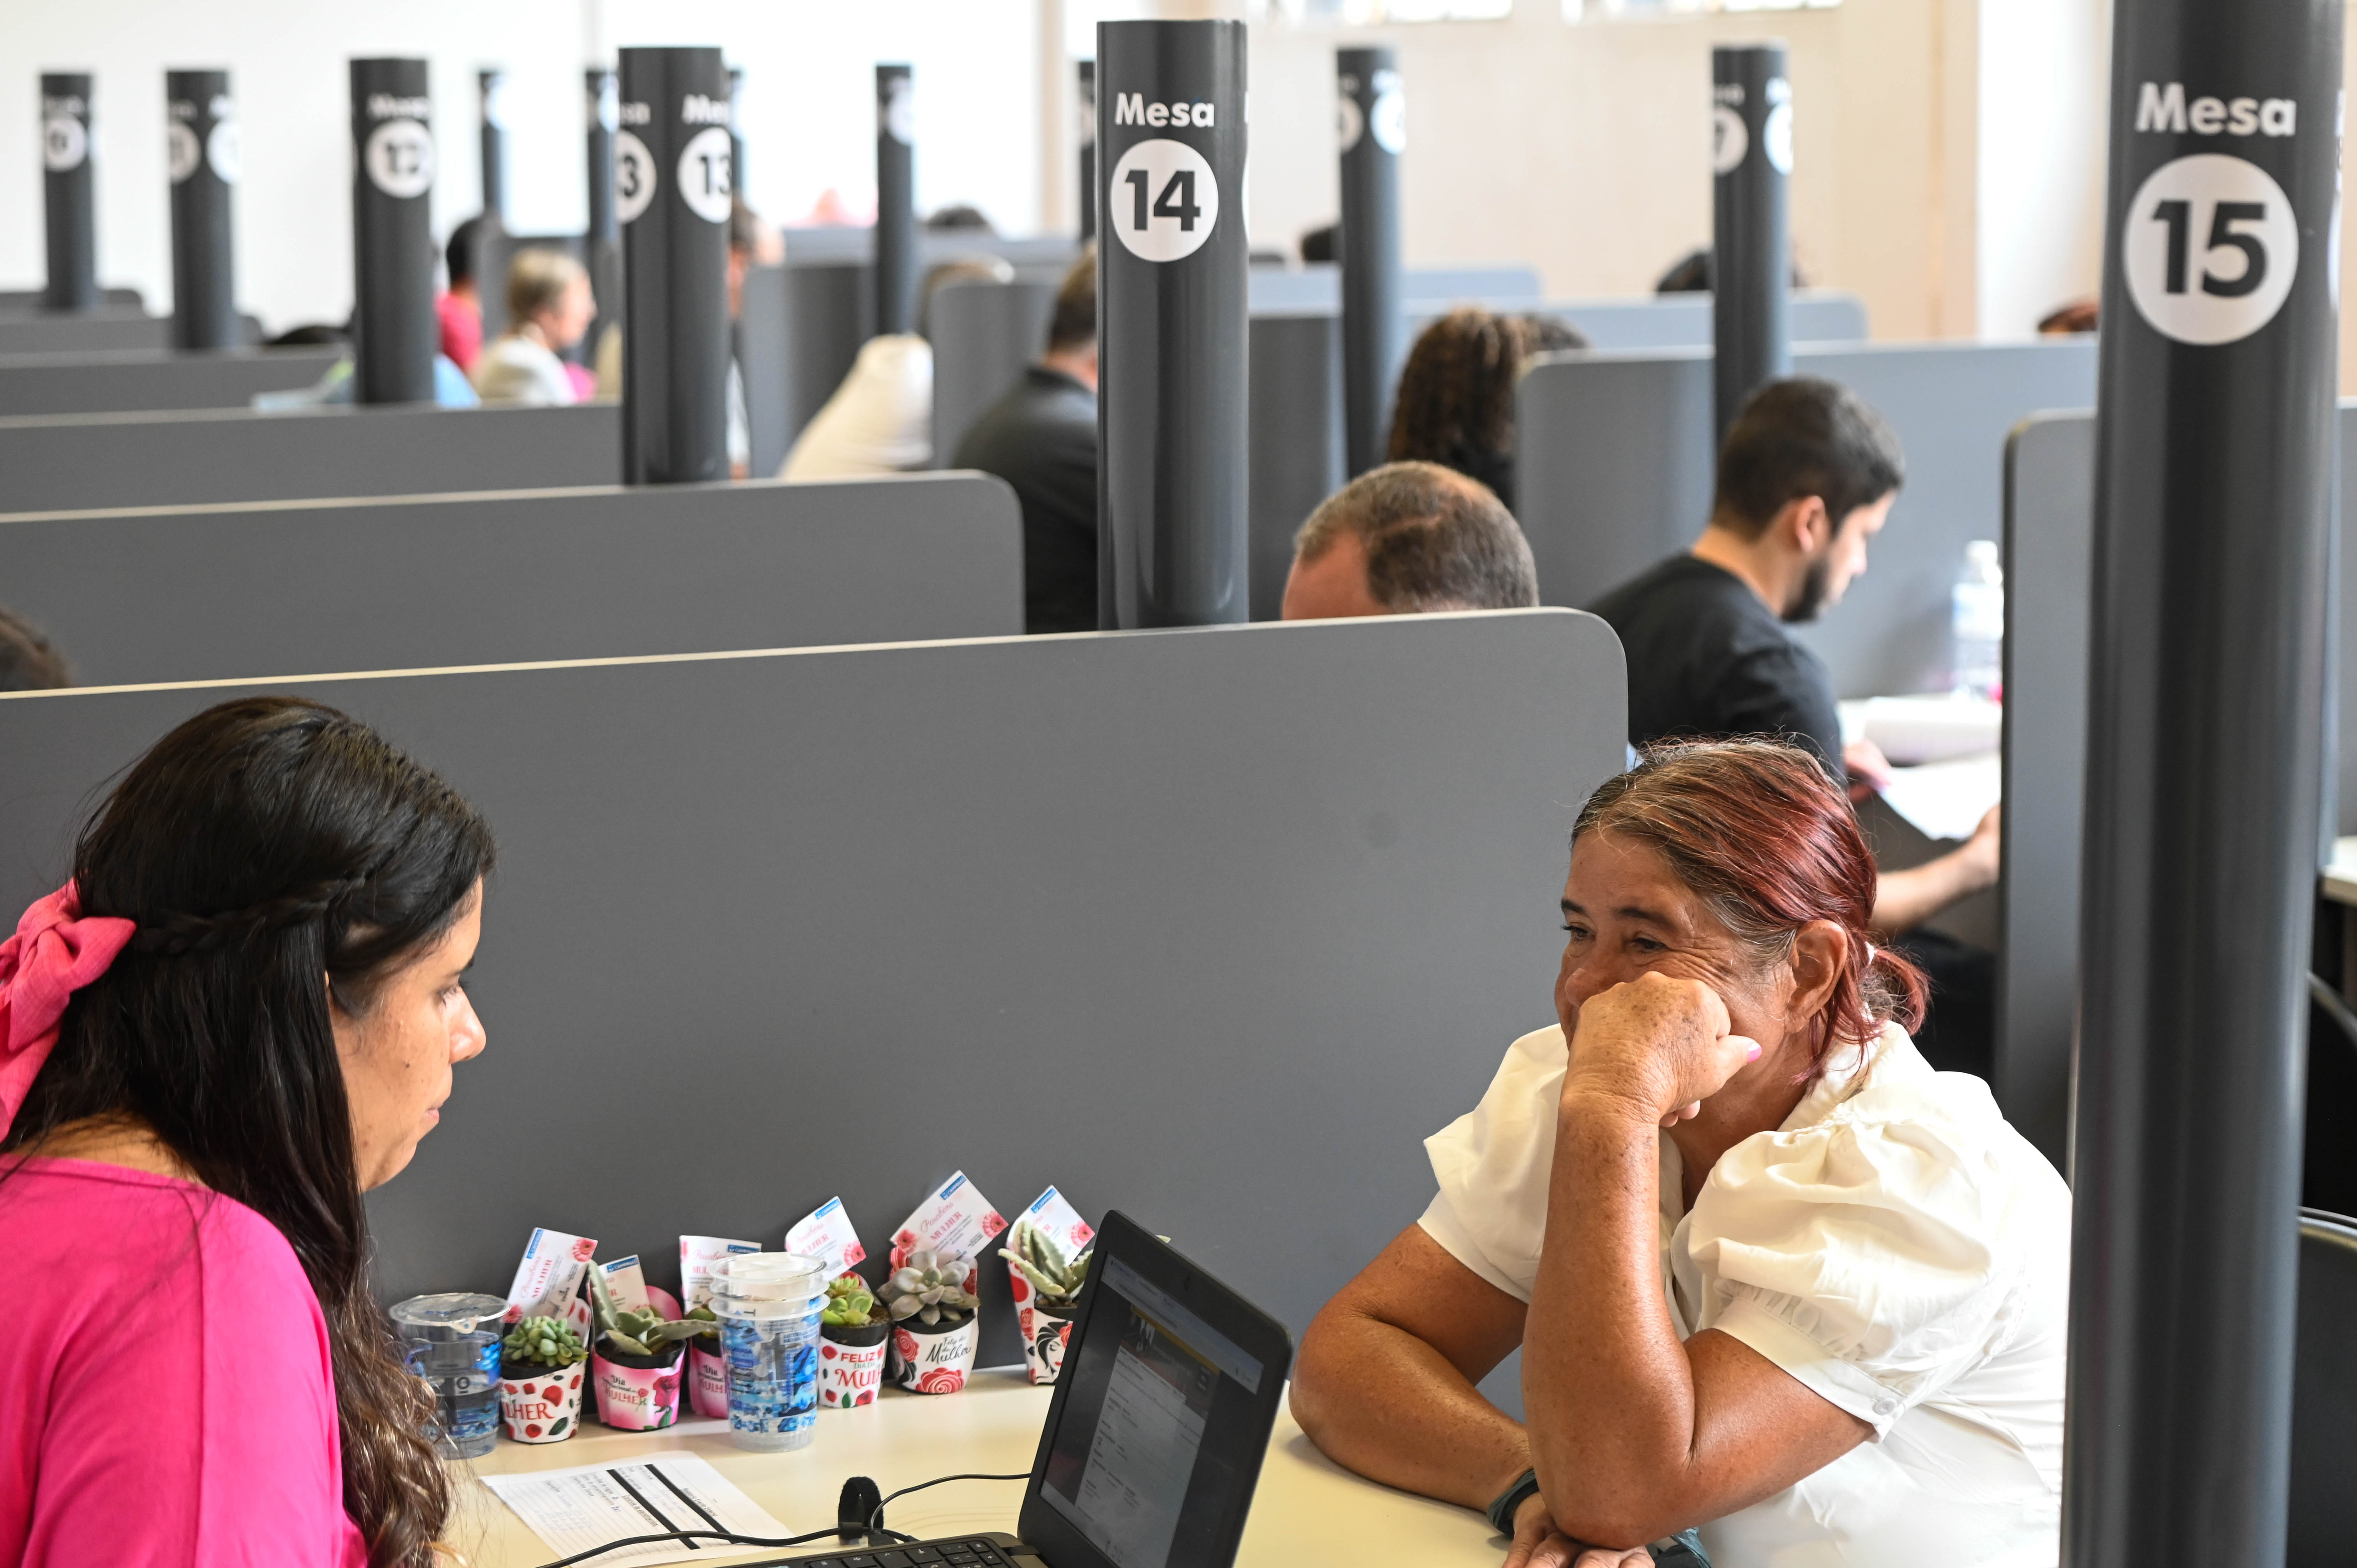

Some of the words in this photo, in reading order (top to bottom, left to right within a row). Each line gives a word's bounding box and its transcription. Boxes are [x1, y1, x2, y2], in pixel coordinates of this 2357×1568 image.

[1115, 93, 1214, 127] Mesa
[2137, 83, 2296, 136] Mesa
[620, 154, 640, 198] 3
[1125, 170, 1200, 231] 14
[2152, 200, 2266, 298] 15
[704, 1365, 718, 1376] Dia
[841, 1352, 875, 1362] FELIZ
[926, 1343, 972, 1364] Mulher
[611, 1374, 625, 1385] Dia
